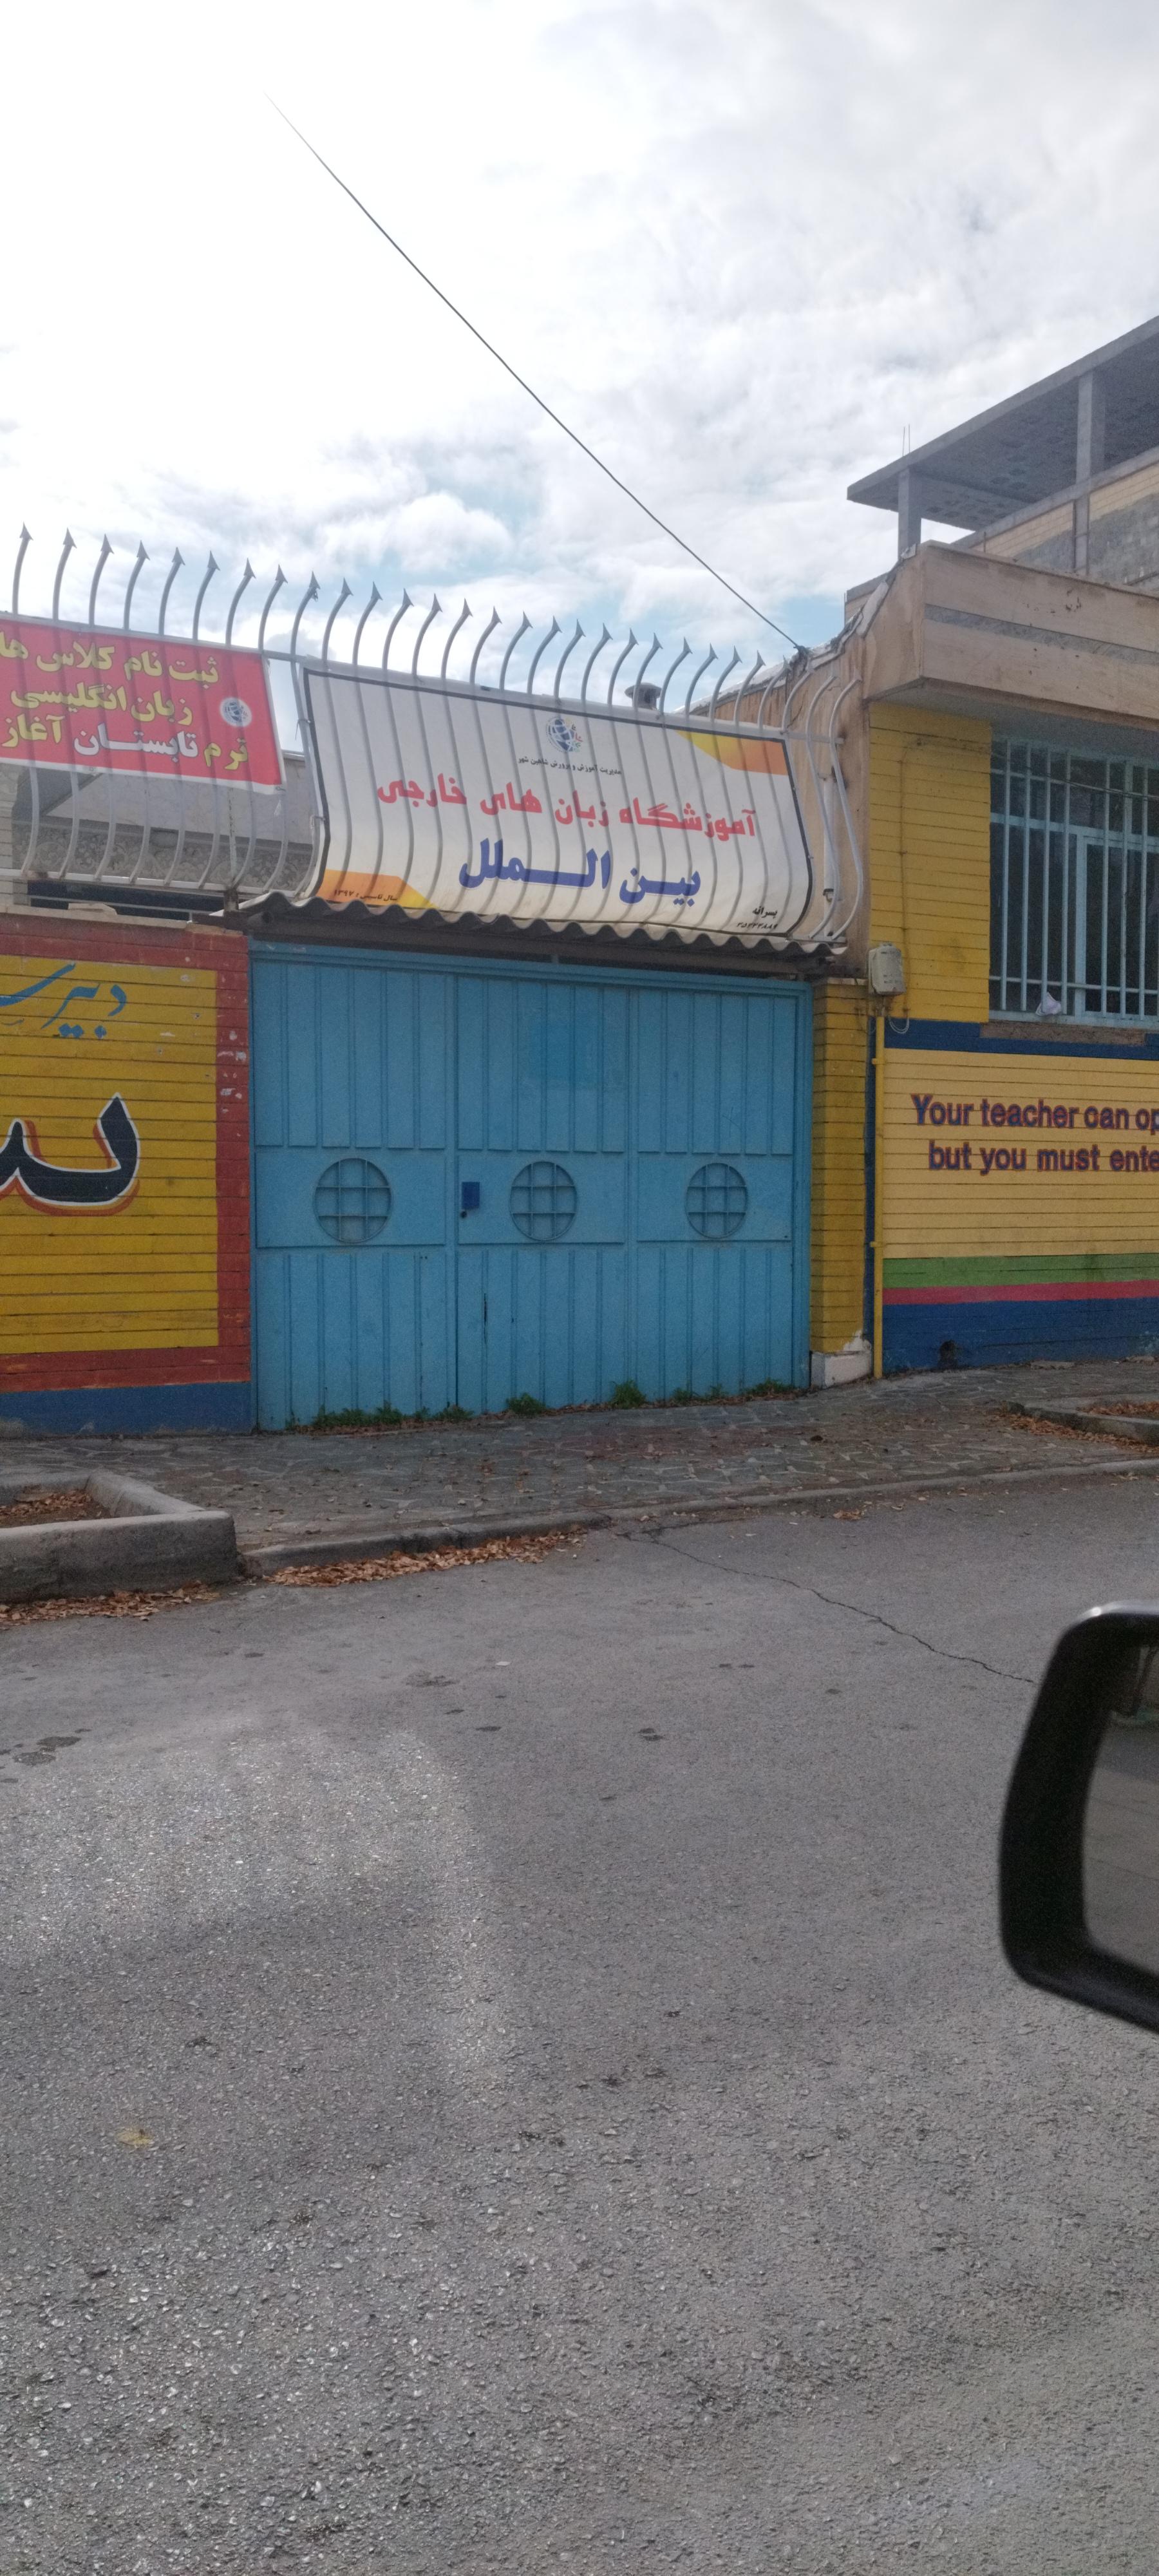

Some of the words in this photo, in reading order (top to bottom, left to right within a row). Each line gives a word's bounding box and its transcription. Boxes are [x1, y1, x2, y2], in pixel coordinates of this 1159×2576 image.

[36, 641, 115, 672] کلاس
[123, 649, 164, 681] نام
[168, 656, 220, 690] ثبت
[10, 682, 127, 712] انگلیسی
[131, 691, 193, 726] زبان
[1, 713, 65, 748] آغاز
[73, 722, 199, 762] تابستان
[203, 737, 249, 770] ترم
[518, 756, 529, 764] شهر
[531, 757, 549, 766] شاهین
[577, 764, 598, 773] آموزش
[377, 773, 467, 808] خارجی
[480, 782, 542, 815] های
[554, 790, 610, 828] زبان
[619, 797, 757, 842] آموزشگاه
[619, 867, 701, 907] بین
[910, 1093, 974, 1126] Your
[980, 1098, 1079, 1128] teacher
[1084, 1105, 1129, 1130] can
[928, 1140, 972, 1170] but
[980, 1147, 1026, 1177] you
[1037, 1144, 1100, 1171] must
